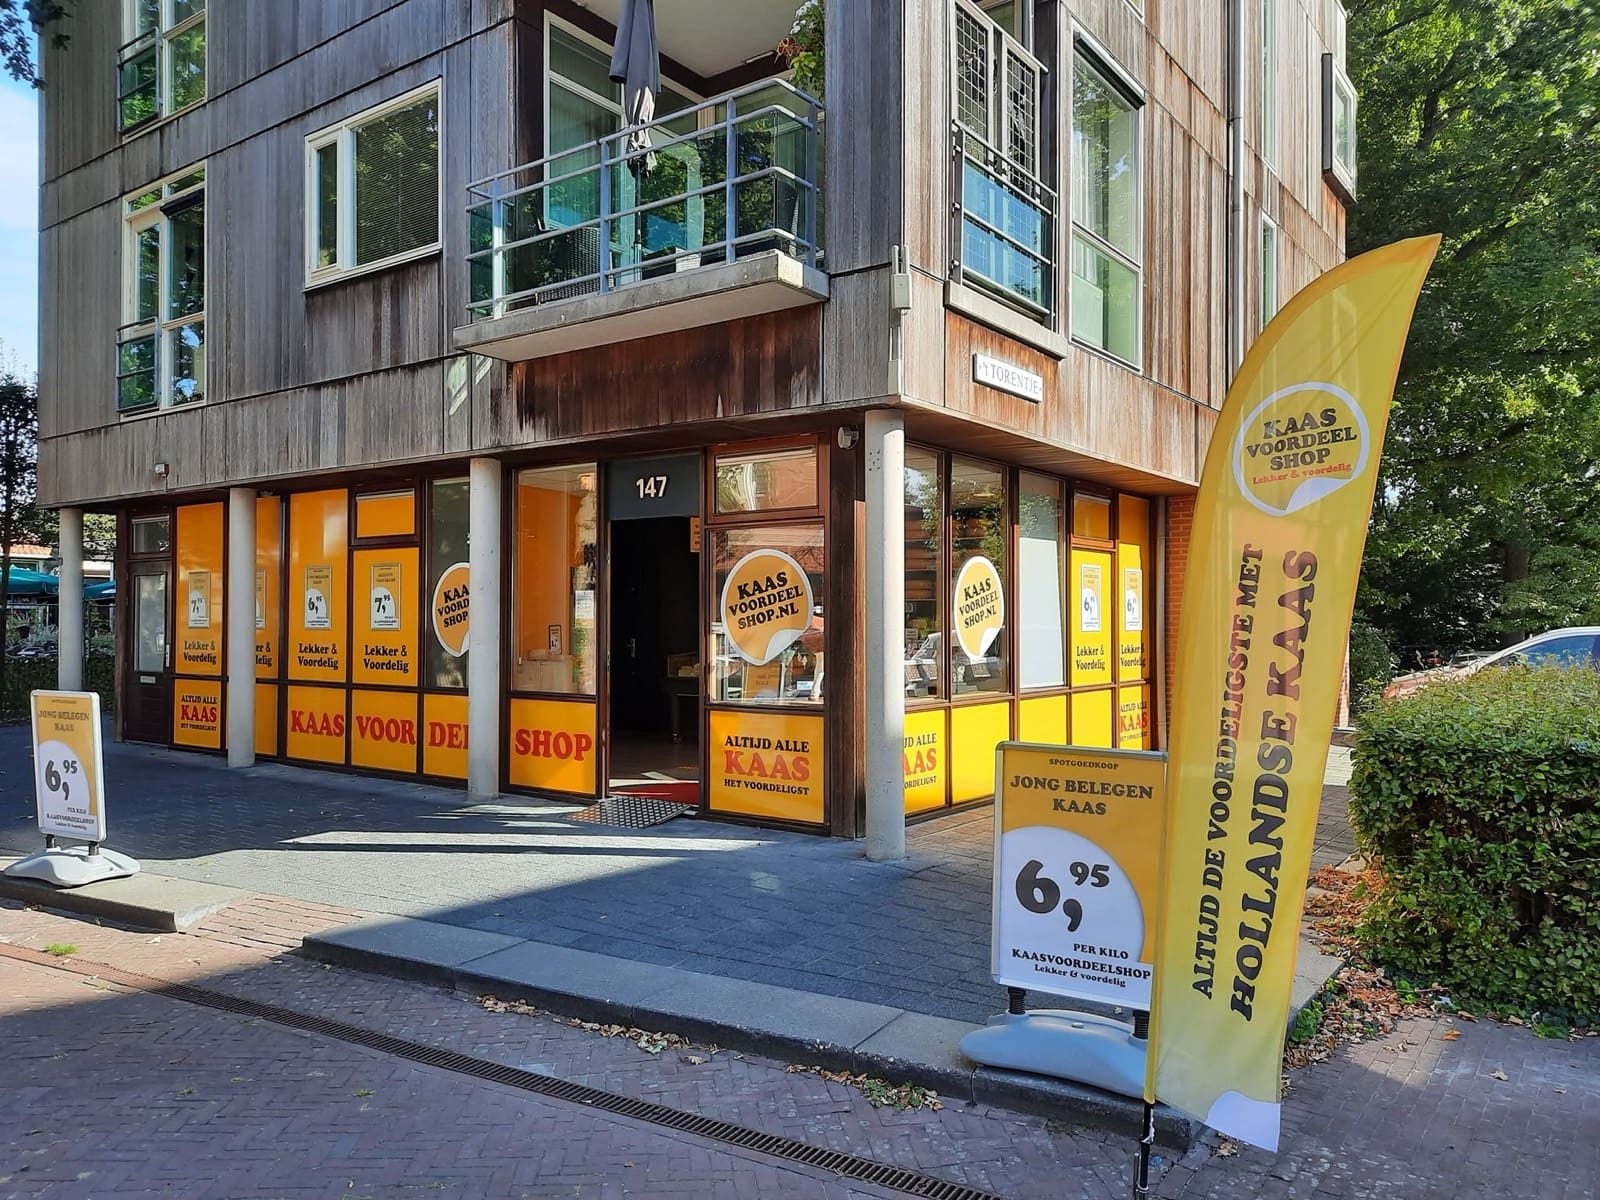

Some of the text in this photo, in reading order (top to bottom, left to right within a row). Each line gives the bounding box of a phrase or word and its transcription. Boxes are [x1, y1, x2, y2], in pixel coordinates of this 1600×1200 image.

[990, 364, 1038, 394] TORENTJE
[1264, 408, 1336, 439] KAAS
[1247, 426, 1357, 458] VOORDEEL
[1270, 448, 1330, 470] SHOP
[1252, 464, 1352, 484] Lekker & voordelig
[636, 476, 668, 498] 147
[737, 572, 788, 600] KAAS
[964, 578, 992, 602] KAAS
[728, 585, 804, 616] VOORDEEL
[959, 590, 999, 616] VOORDEEL
[738, 603, 799, 630] SHOP.NL
[964, 605, 997, 629] SHOP.NL
[184, 640, 209, 651] Lekker
[298, 643, 337, 654] Lekker &
[364, 645, 408, 656] Lekker &
[1076, 646, 1098, 656] Lekker
[1120, 644, 1140, 654] Lekker
[184, 652, 216, 665] Voordelig
[298, 656, 338, 670] Voordelig
[363, 658, 409, 674] Voordelig
[1076, 659, 1105, 671] Voordelig
[181, 694, 217, 704] ALTIJD ALLE
[181, 704, 217, 722] KAAS
[1120, 711, 1148, 732] KAAS
[290, 710, 344, 737] KAAS
[356, 716, 416, 745] VOOR
[515, 728, 592, 762] SHOP
[724, 736, 810, 752] ALTIJD ALLE
[916, 733, 937, 746] ALLE
[724, 750, 810, 782] KAAS
[1048, 758, 1119, 770] SPOTGOEDKOOP
[1192, 544, 1263, 1000] ALTIJD DE VOORDELIGSTE MET
[45, 760, 78, 801] 6,95
[724, 779, 810, 796] HET VOORDELIGST
[1010, 776, 1154, 800] JONG BELEGEN
[1230, 550, 1318, 1022] HOLLANDSE KAAS
[1052, 798, 1107, 815] KAAS
[1016, 860, 1110, 932] 6,95
[1073, 944, 1128, 959] PER KILO
[1012, 948, 1151, 979] KAASVOORDEELSHOP
[1034, 964, 1126, 988] Lekker & voordelig
